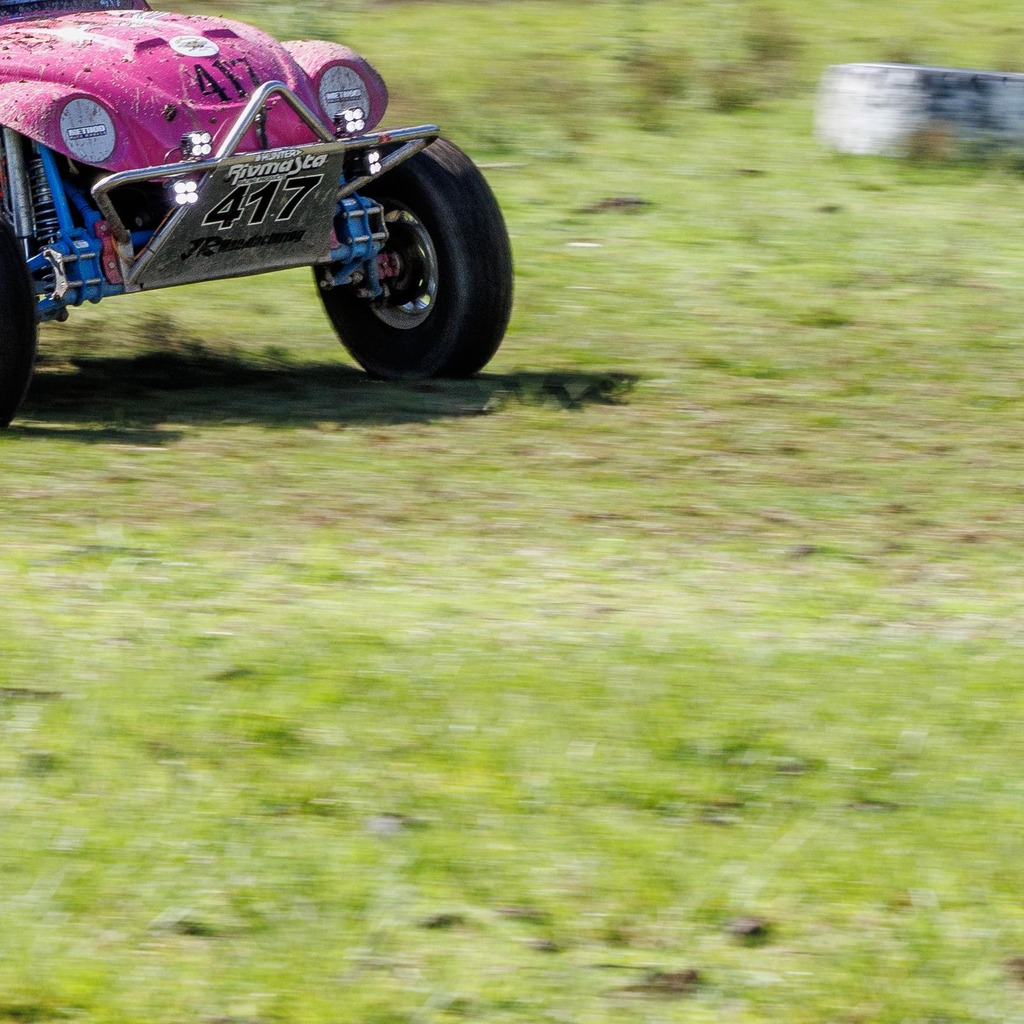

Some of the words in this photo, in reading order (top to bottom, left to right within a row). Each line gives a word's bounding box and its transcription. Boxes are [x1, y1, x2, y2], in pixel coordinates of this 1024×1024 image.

[194, 57, 260, 101] 417
[227, 154, 328, 186] Rivmasta
[201, 173, 325, 231] 417
